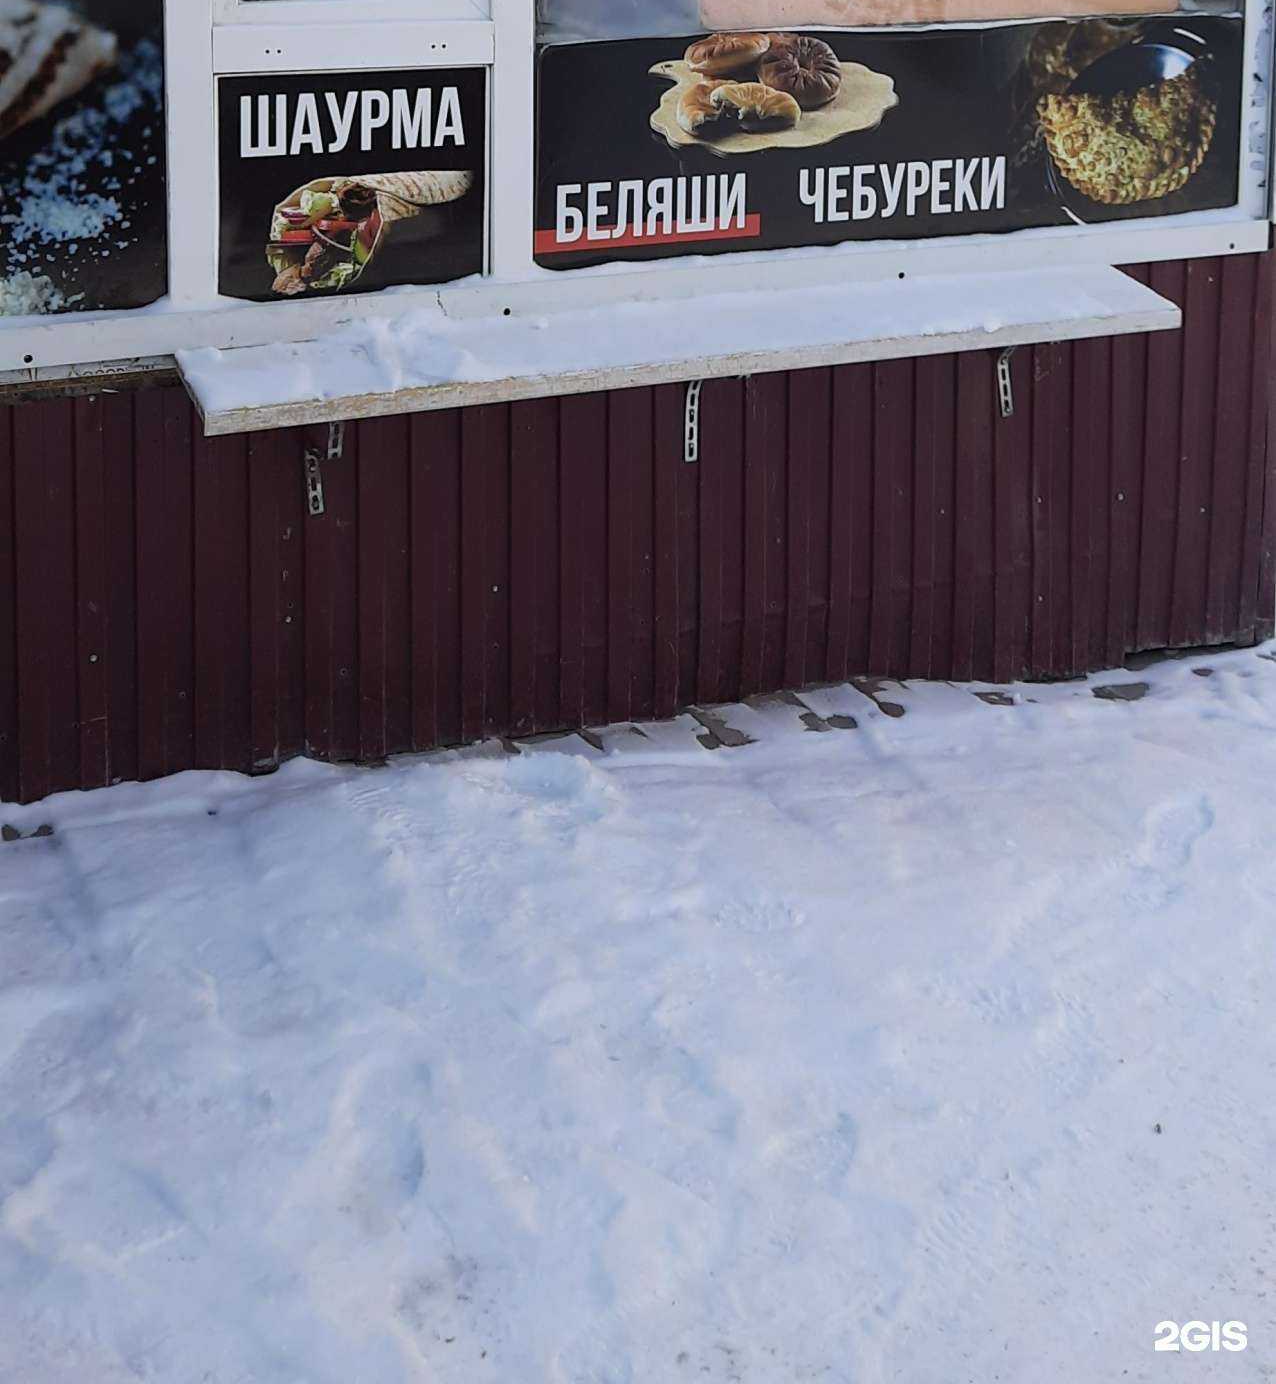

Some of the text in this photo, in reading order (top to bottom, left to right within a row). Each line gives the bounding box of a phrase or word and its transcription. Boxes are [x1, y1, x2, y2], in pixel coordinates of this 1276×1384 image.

[240, 86, 466, 158] ШАУРМА
[555, 155, 1007, 244] БЕЛЯШИ ЧЕБУРЕКИ
